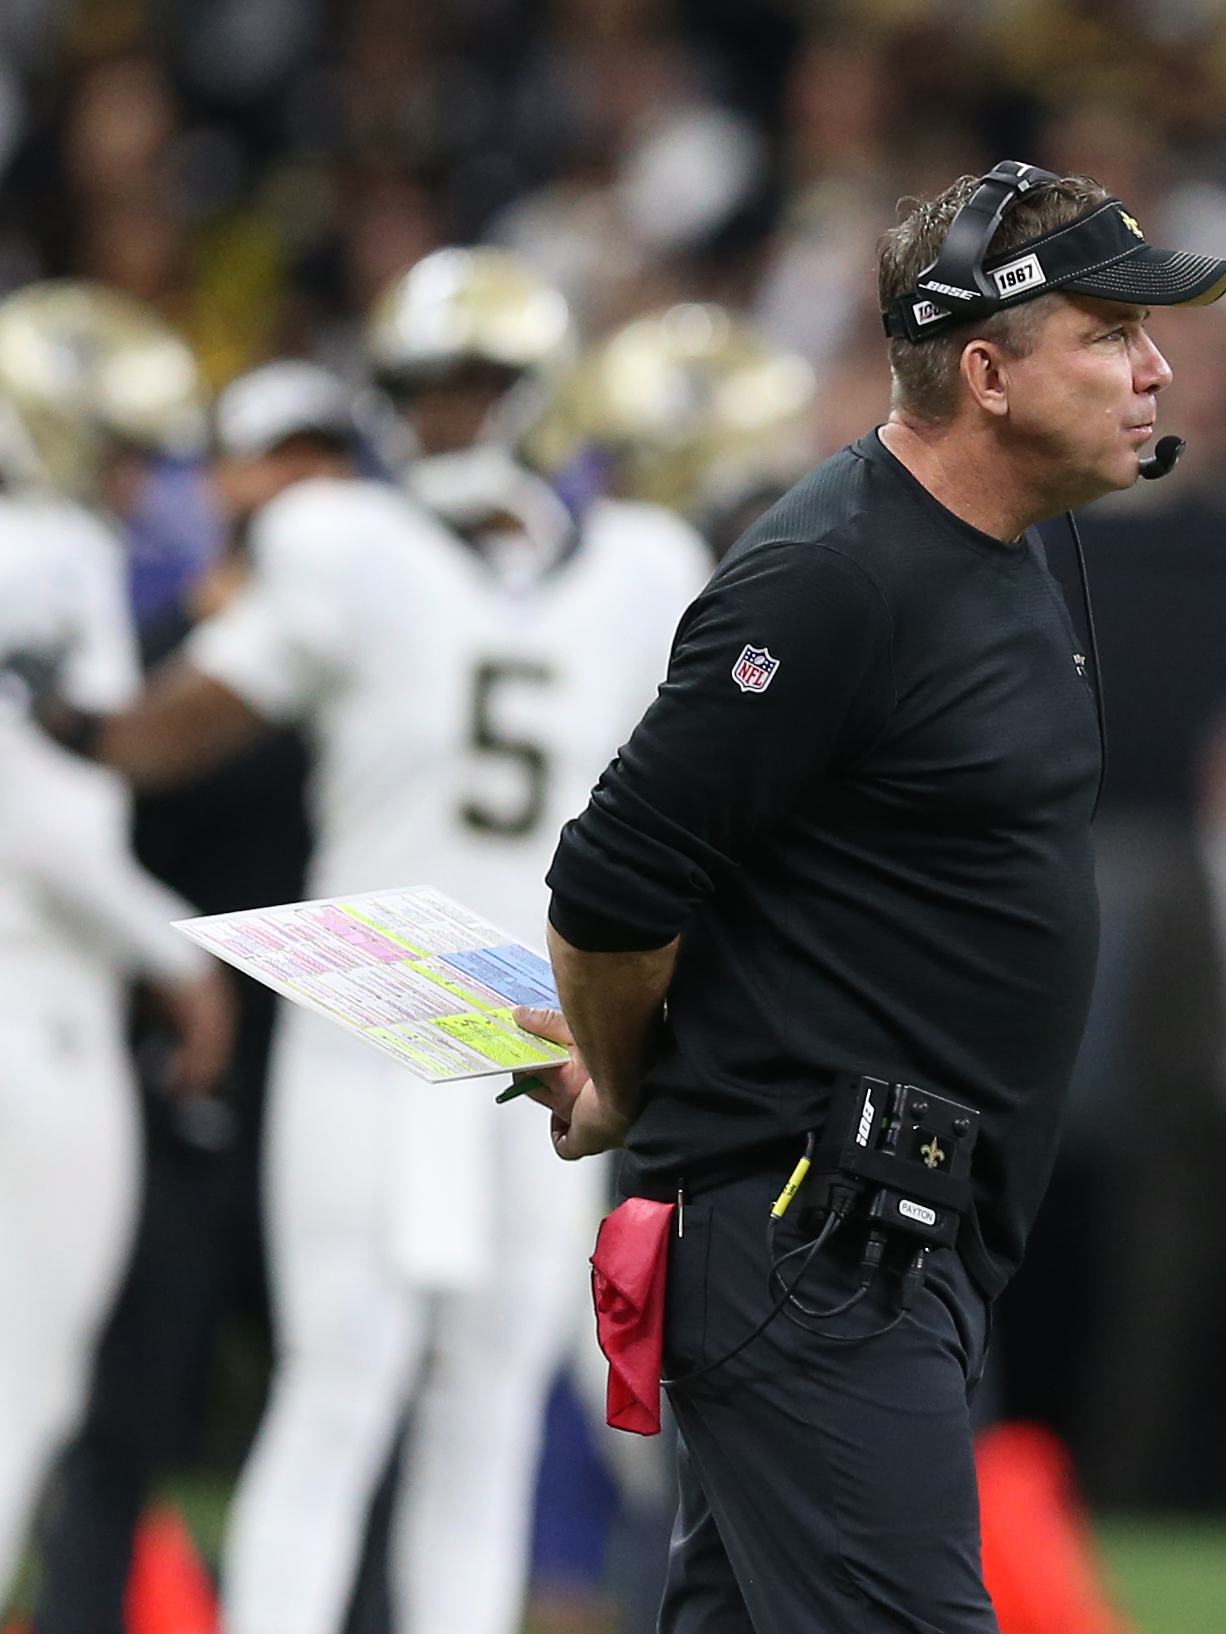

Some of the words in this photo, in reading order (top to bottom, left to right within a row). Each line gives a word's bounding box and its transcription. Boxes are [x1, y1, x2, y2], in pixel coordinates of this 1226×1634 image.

[998, 263, 1034, 290] 1967
[918, 280, 982, 301] BOSE
[737, 661, 765, 686] NFL
[459, 660, 566, 840] 5
[901, 1203, 934, 1222] PAYTON
